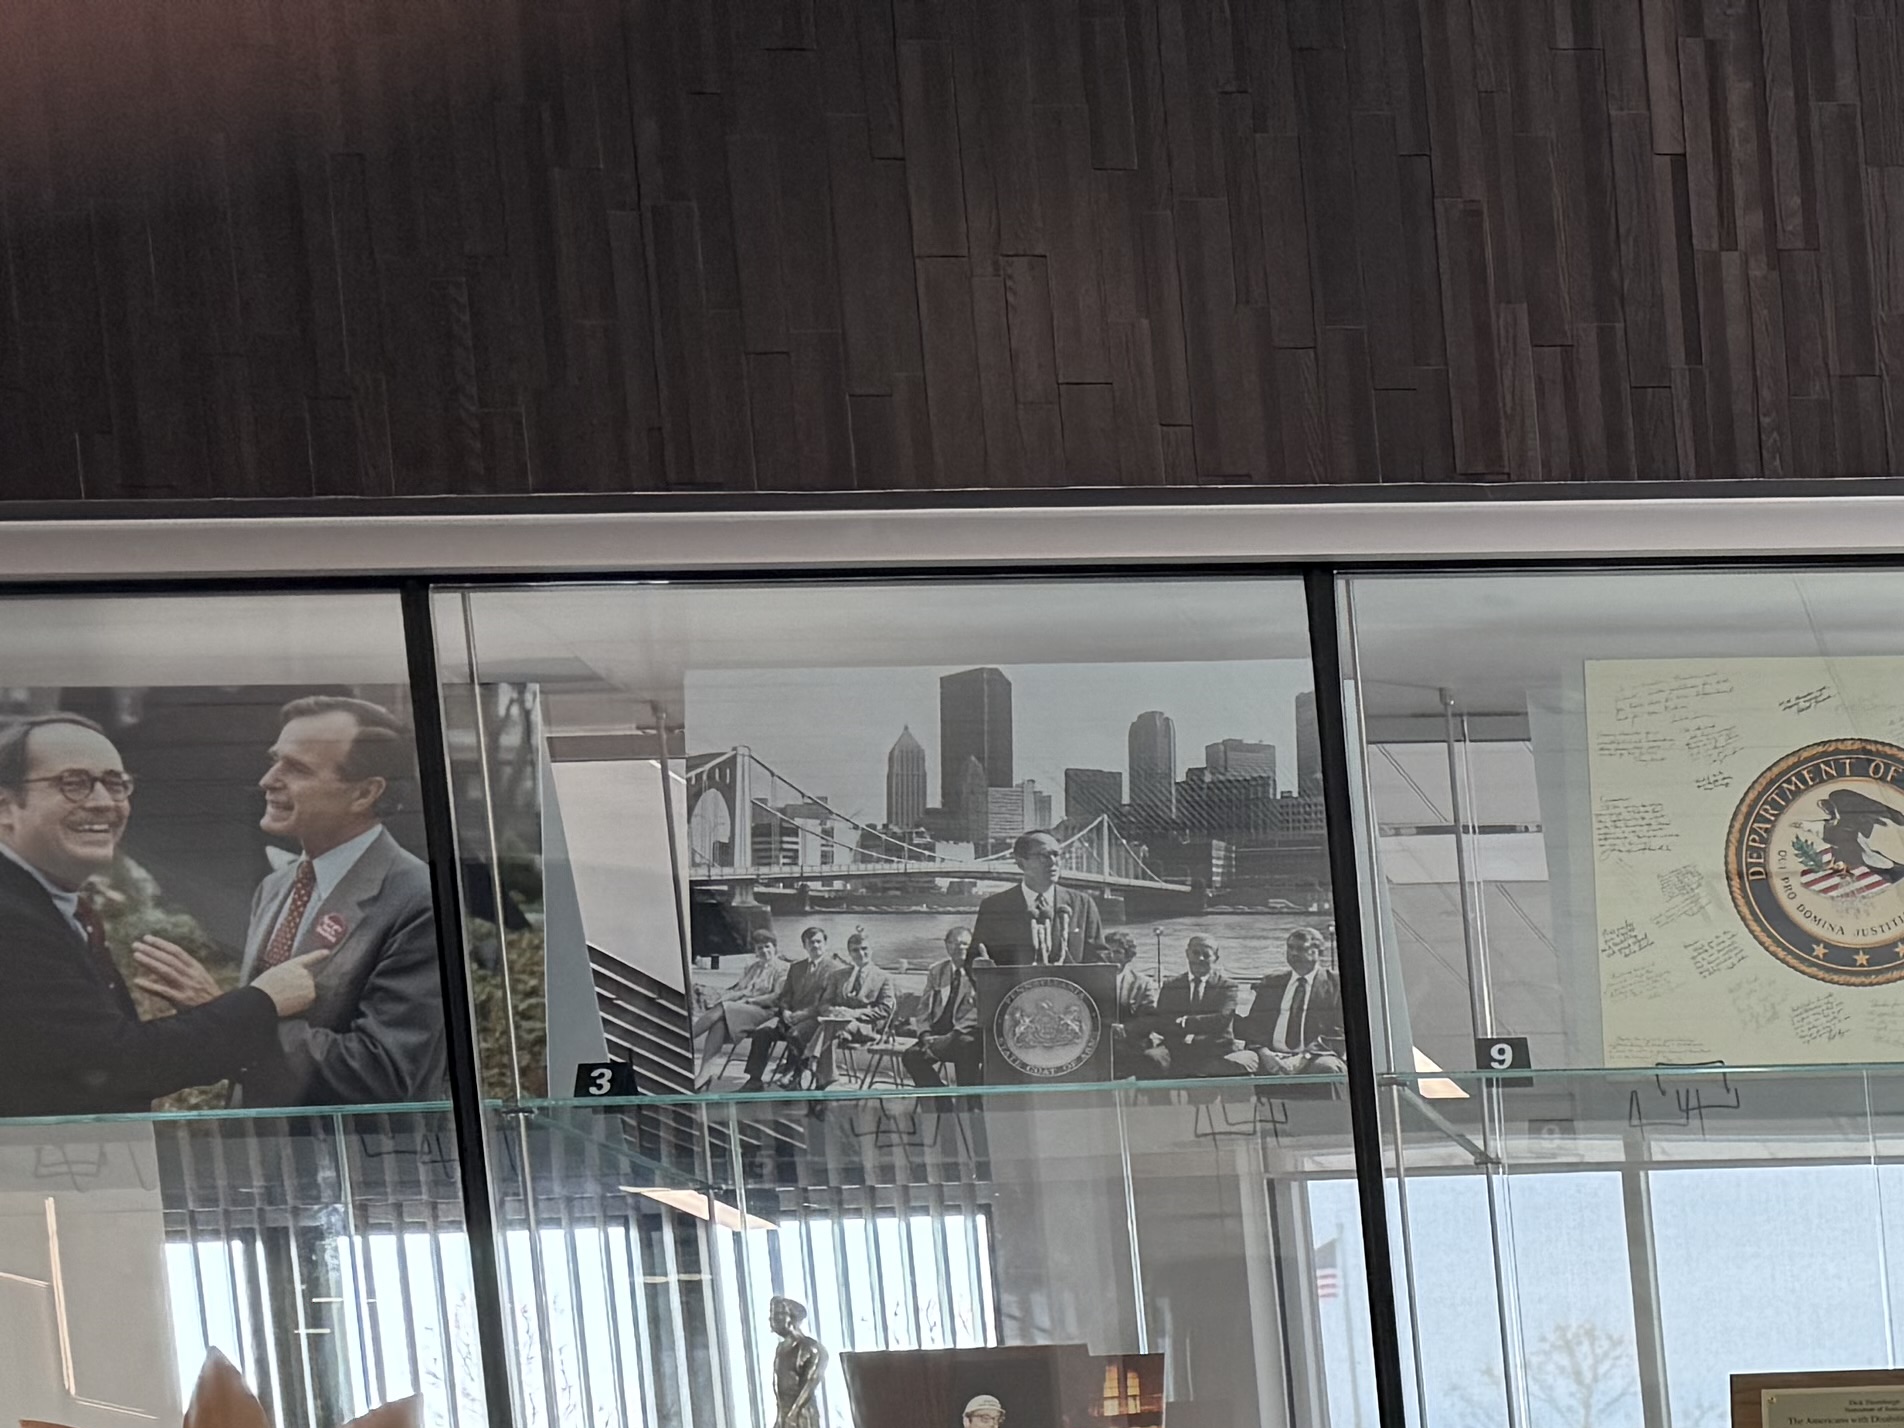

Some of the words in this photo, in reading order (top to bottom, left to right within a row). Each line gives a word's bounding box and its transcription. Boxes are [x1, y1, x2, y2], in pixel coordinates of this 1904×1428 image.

[1748, 759, 1855, 881] DEPARTMENT
[1869, 760, 1902, 783] OF
[1781, 877, 1797, 901] PRO
[1796, 903, 1845, 936] DOMINA
[1490, 1043, 1513, 1069] 9
[588, 1068, 613, 1095] 3
